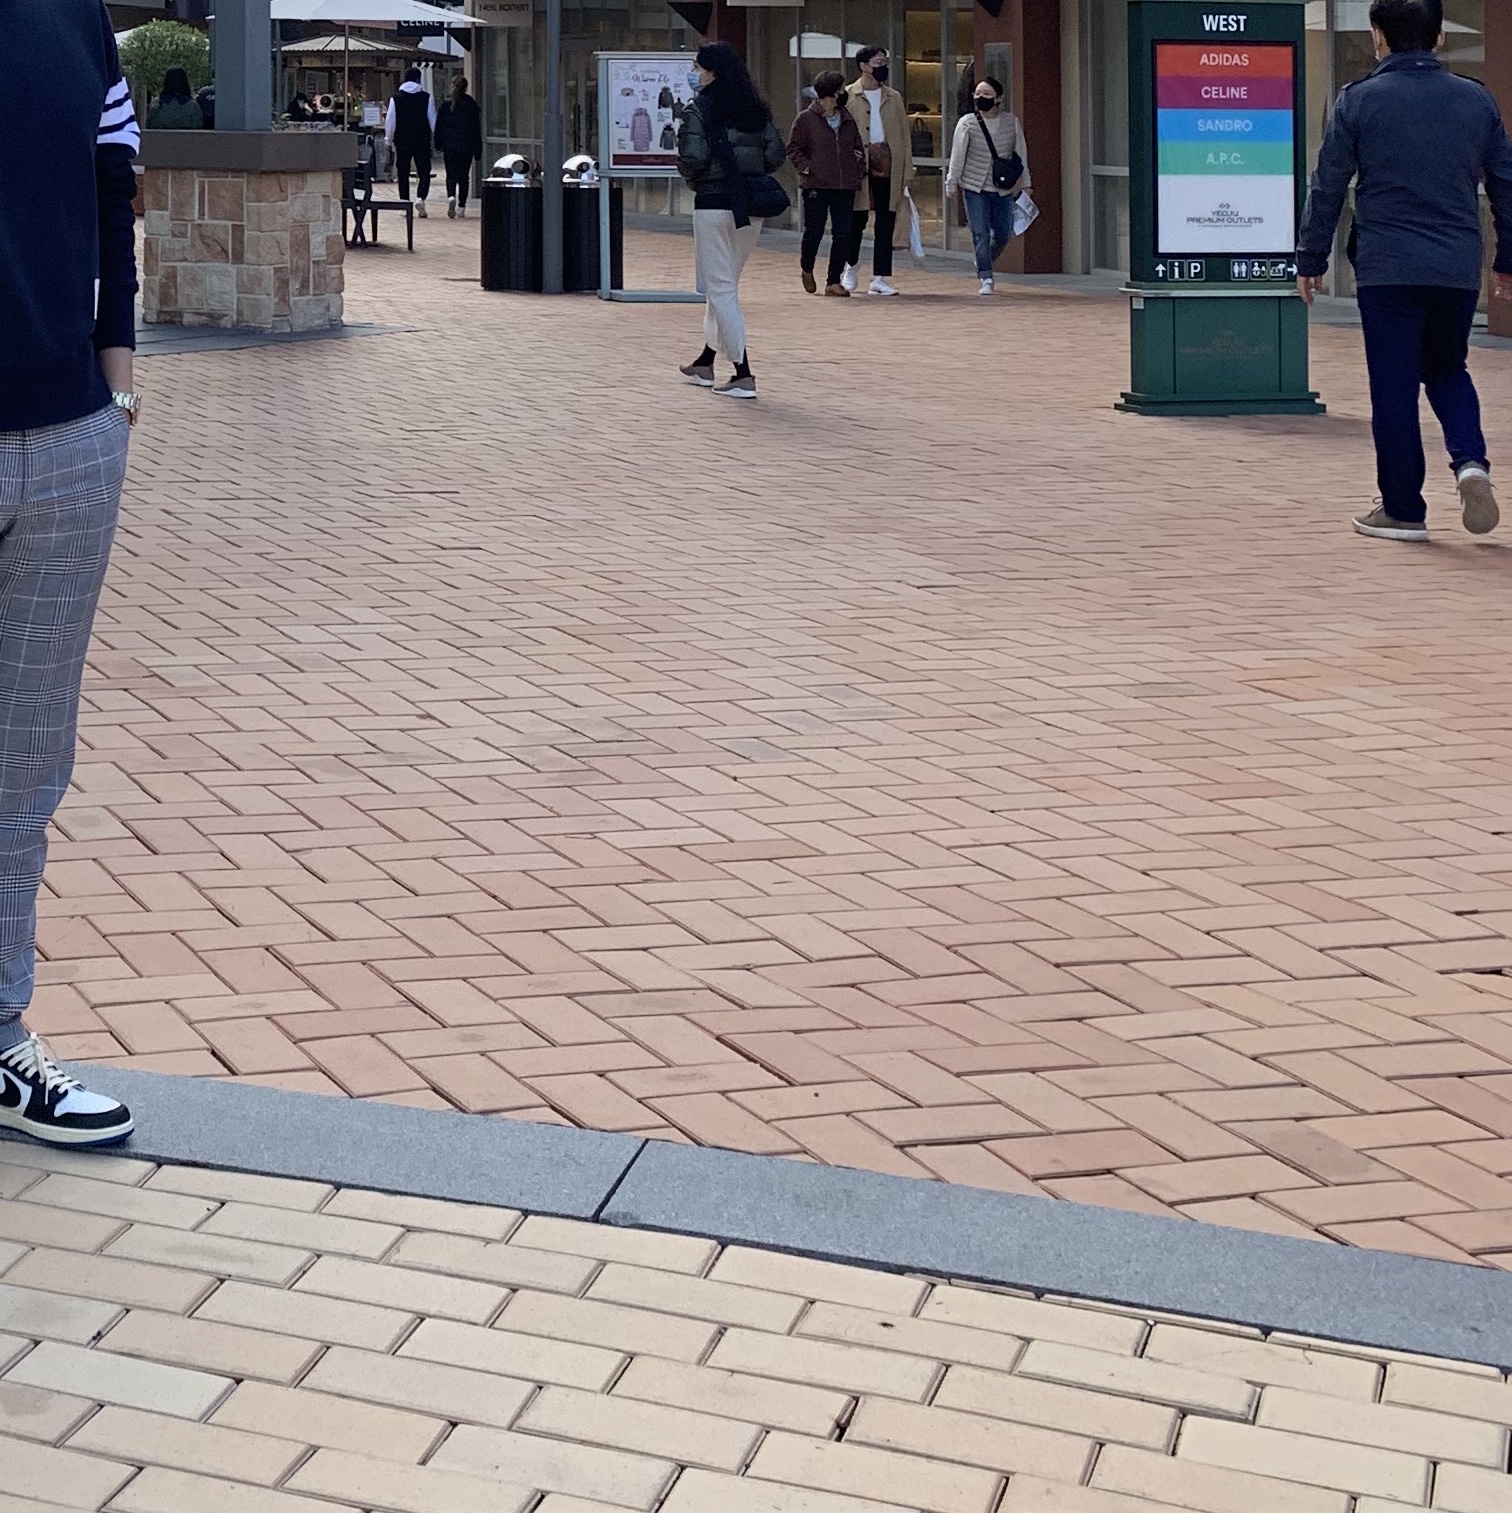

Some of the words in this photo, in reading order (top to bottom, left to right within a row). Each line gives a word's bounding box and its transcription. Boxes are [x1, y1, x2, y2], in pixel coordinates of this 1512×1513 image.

[1202, 14, 1247, 32] WEST
[1199, 53, 1250, 67] ADIDAS
[1200, 86, 1248, 99] CELINE
[1197, 119, 1253, 132] SANDRO
[1205, 152, 1245, 166] A.P.C.
[1186, 216, 1226, 224] PREMIUM
[1226, 216, 1265, 224] OUTLETS
